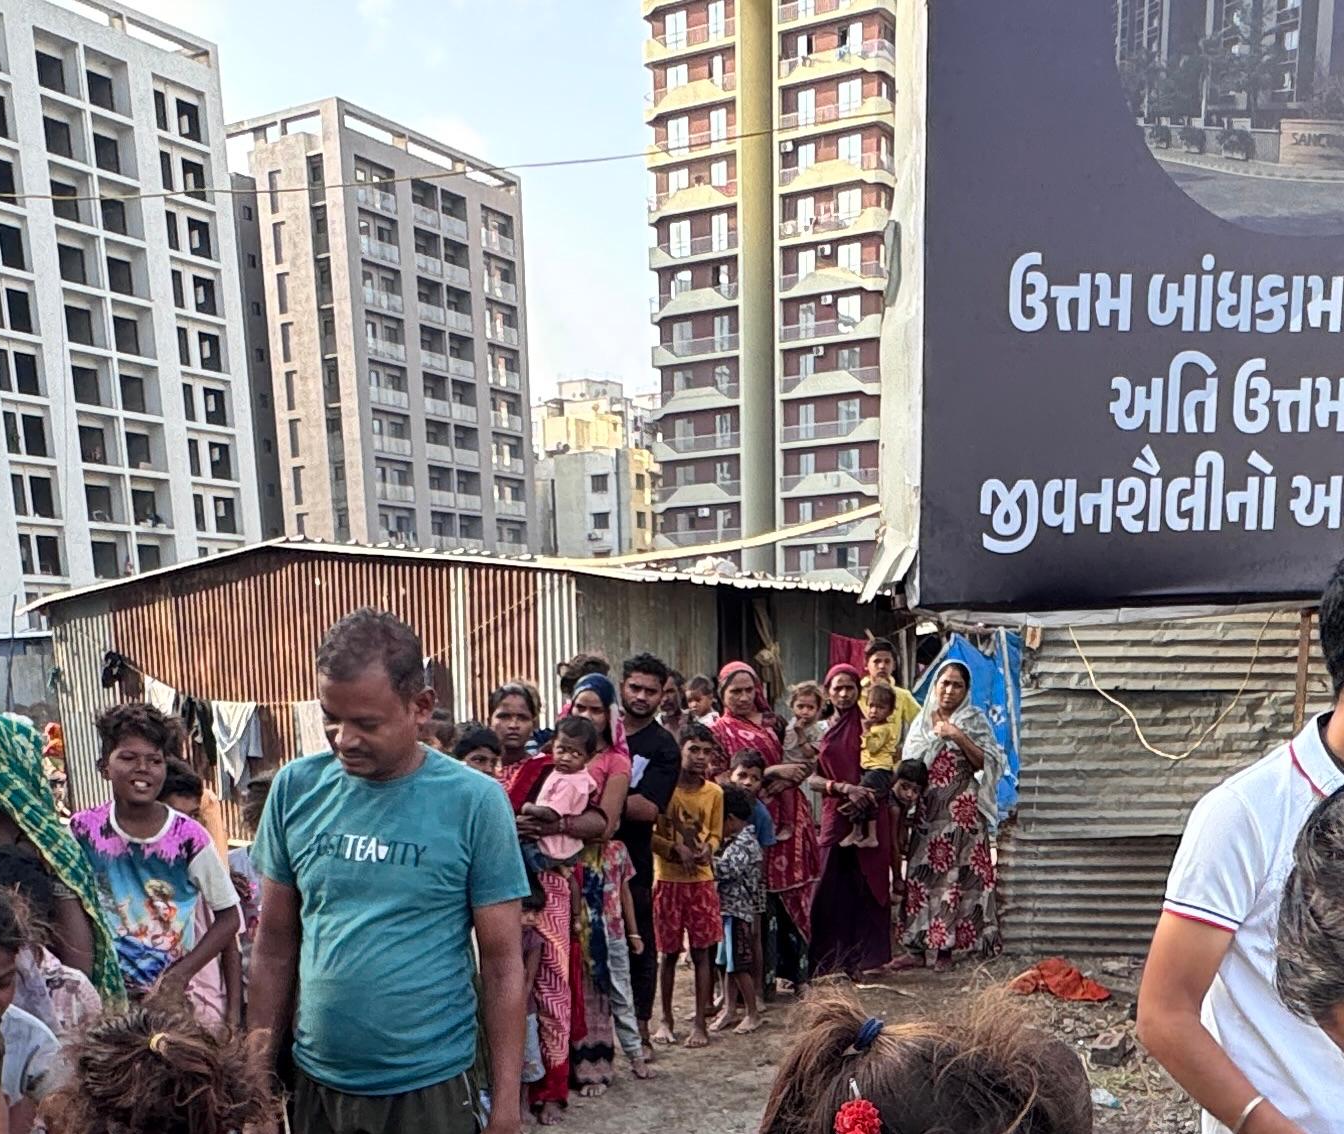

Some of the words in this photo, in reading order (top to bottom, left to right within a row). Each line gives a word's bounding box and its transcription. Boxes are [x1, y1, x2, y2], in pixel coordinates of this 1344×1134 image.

[1008, 251, 1133, 332] ઉત્તમ
[1147, 253, 1344, 333] બાંધકામ
[1109, 350, 1218, 433] અતિ
[980, 444, 1276, 554] જીવનશૈલીનો
